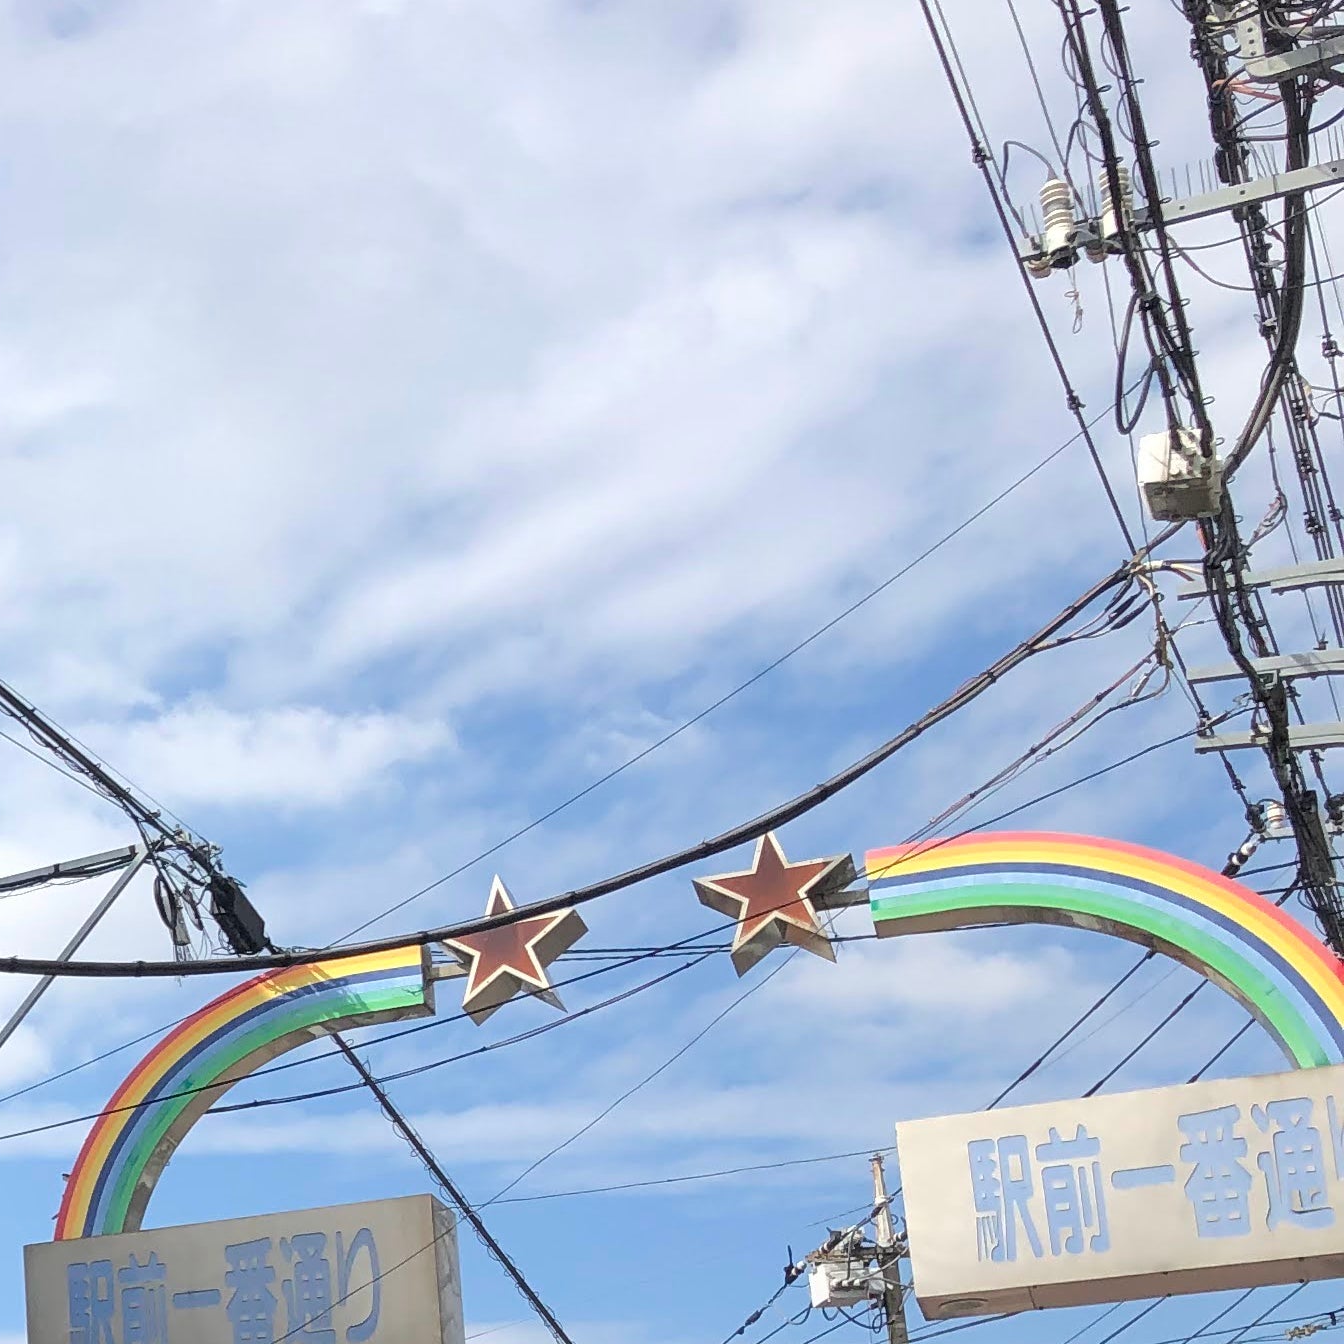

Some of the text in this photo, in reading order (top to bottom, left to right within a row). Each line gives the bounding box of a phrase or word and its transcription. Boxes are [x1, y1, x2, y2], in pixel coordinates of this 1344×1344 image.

[67, 1227, 382, 1344] 駅前一番通り
